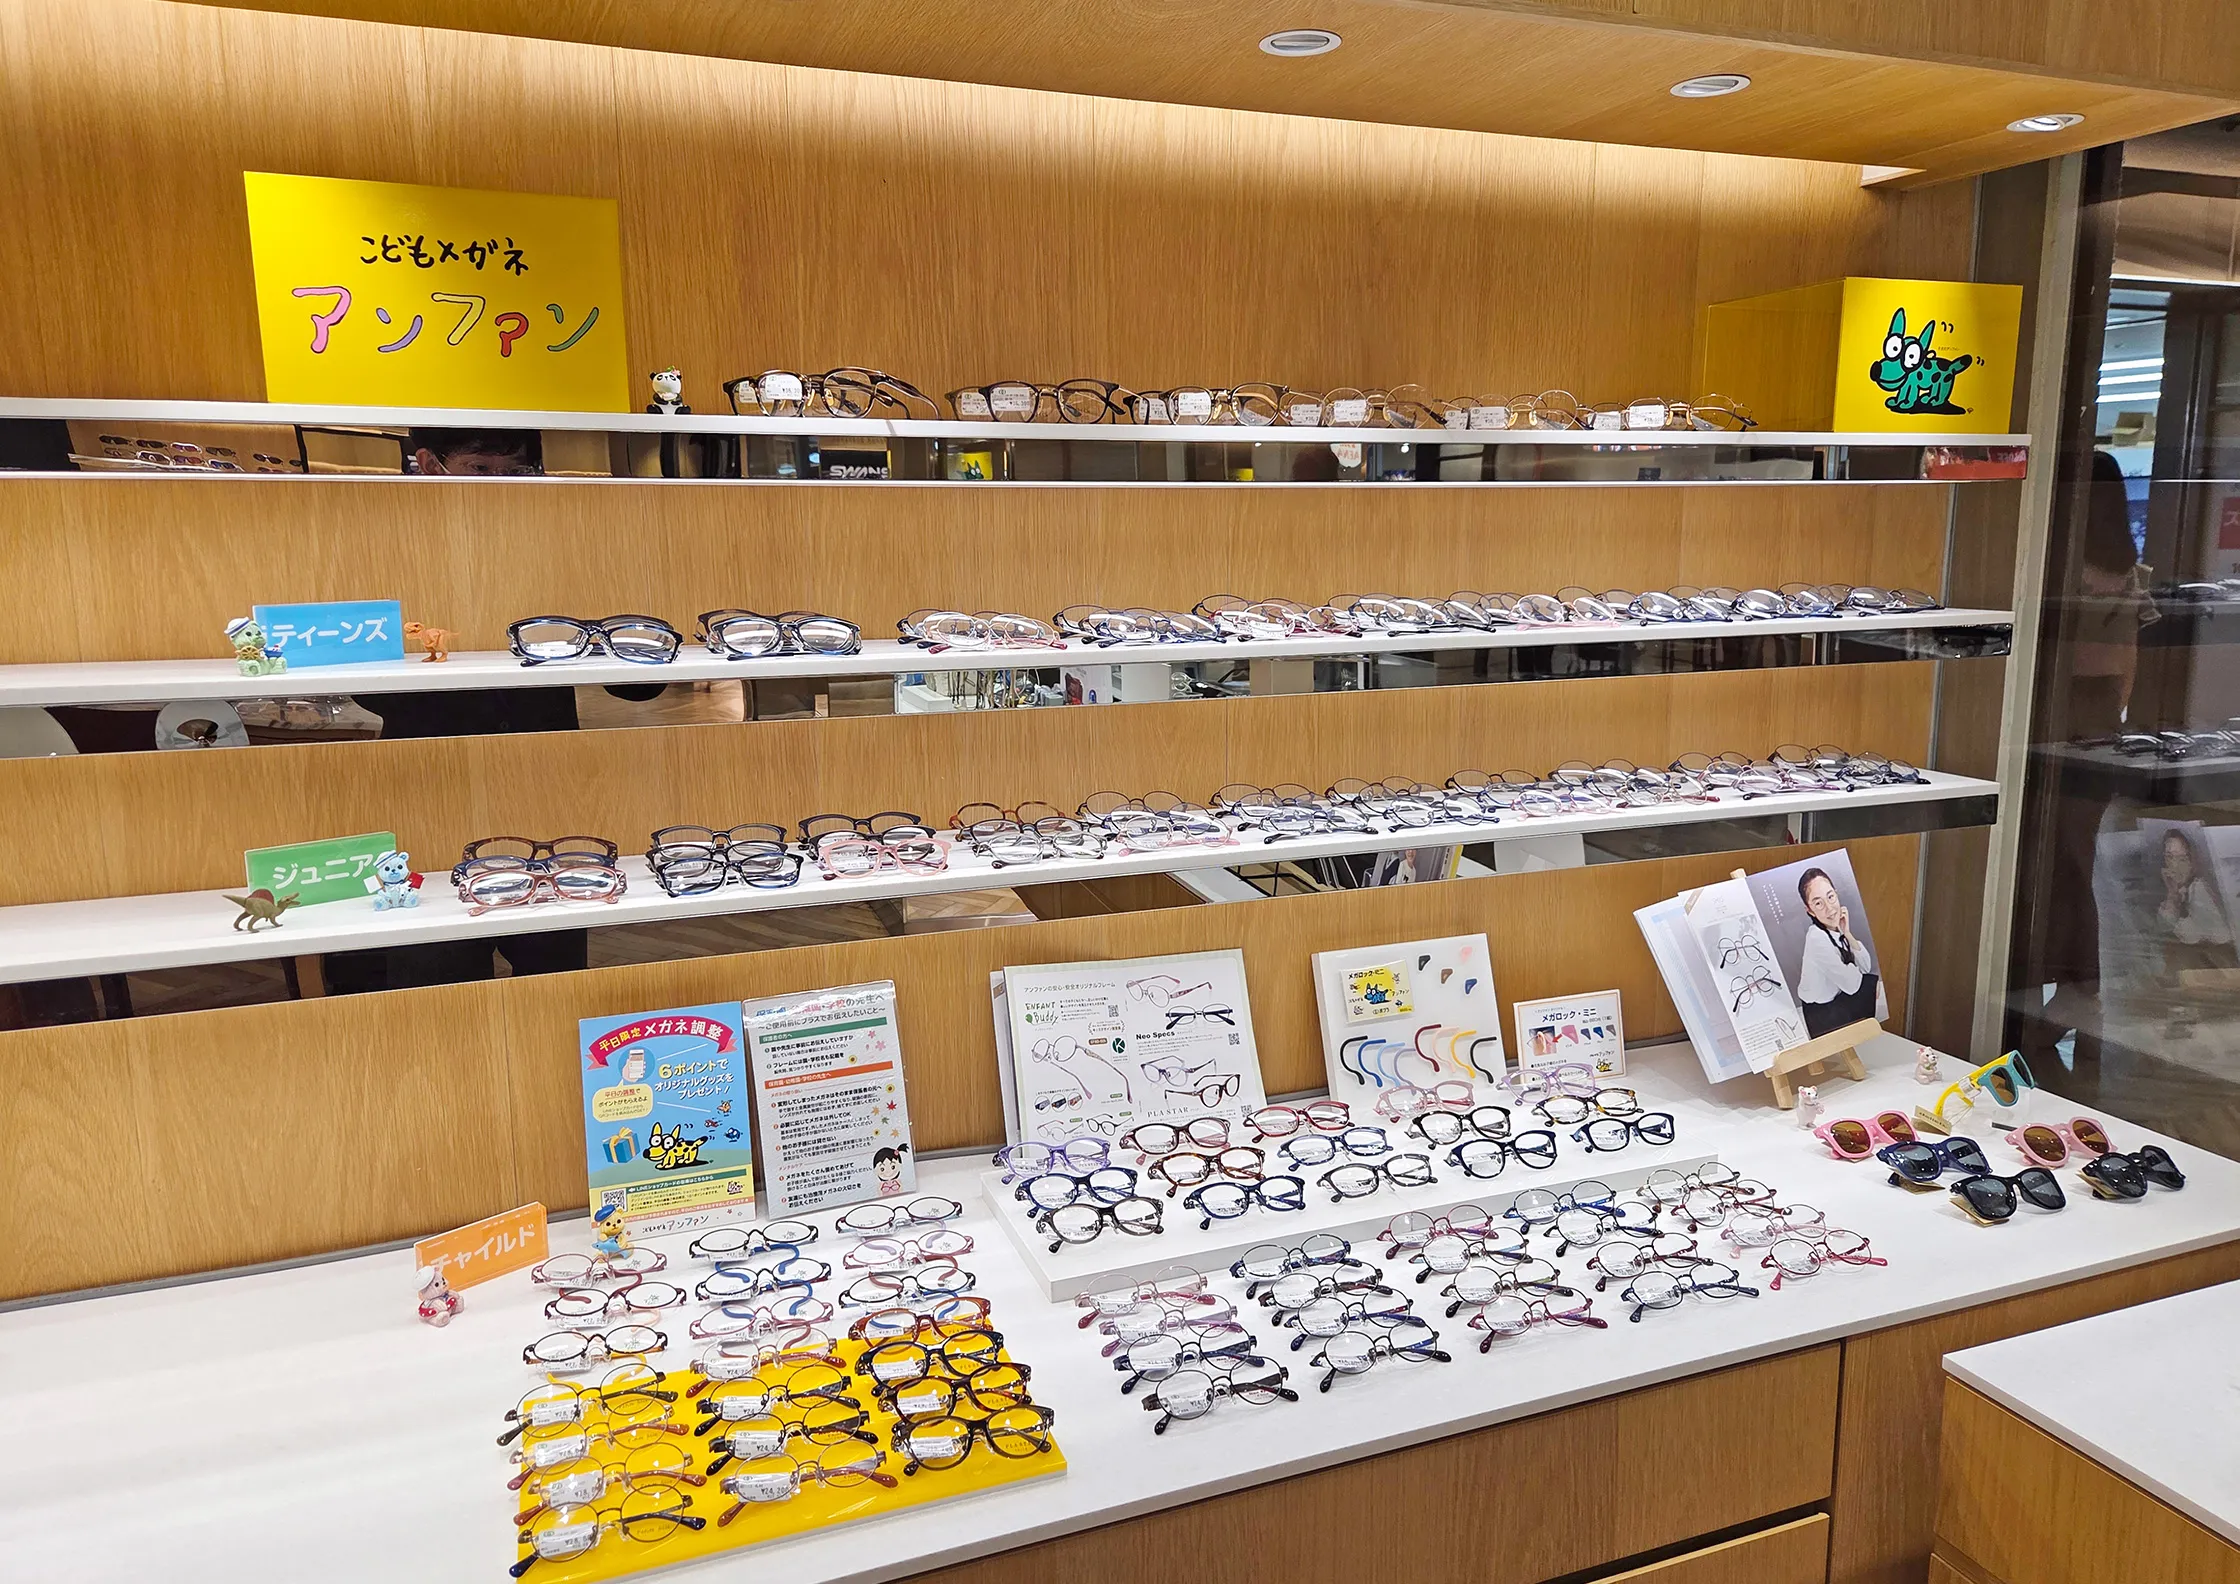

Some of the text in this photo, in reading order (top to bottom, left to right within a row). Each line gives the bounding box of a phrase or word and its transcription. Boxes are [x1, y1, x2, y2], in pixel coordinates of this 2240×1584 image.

[360, 234, 529, 276] こどもメガネ
[291, 285, 600, 358] アンファン
[272, 854, 373, 886] ジュニア
[1033, 1010, 1059, 1025] Buddy
[1542, 1008, 1597, 1023] メガロック・ミニ
[599, 1019, 724, 1051] 平日限定 メガネ調整
[1152, 1031, 1175, 1039] Specs
[658, 1058, 728, 1080] 6ポイントで
[655, 1072, 734, 1092] オリジナルグッズを
